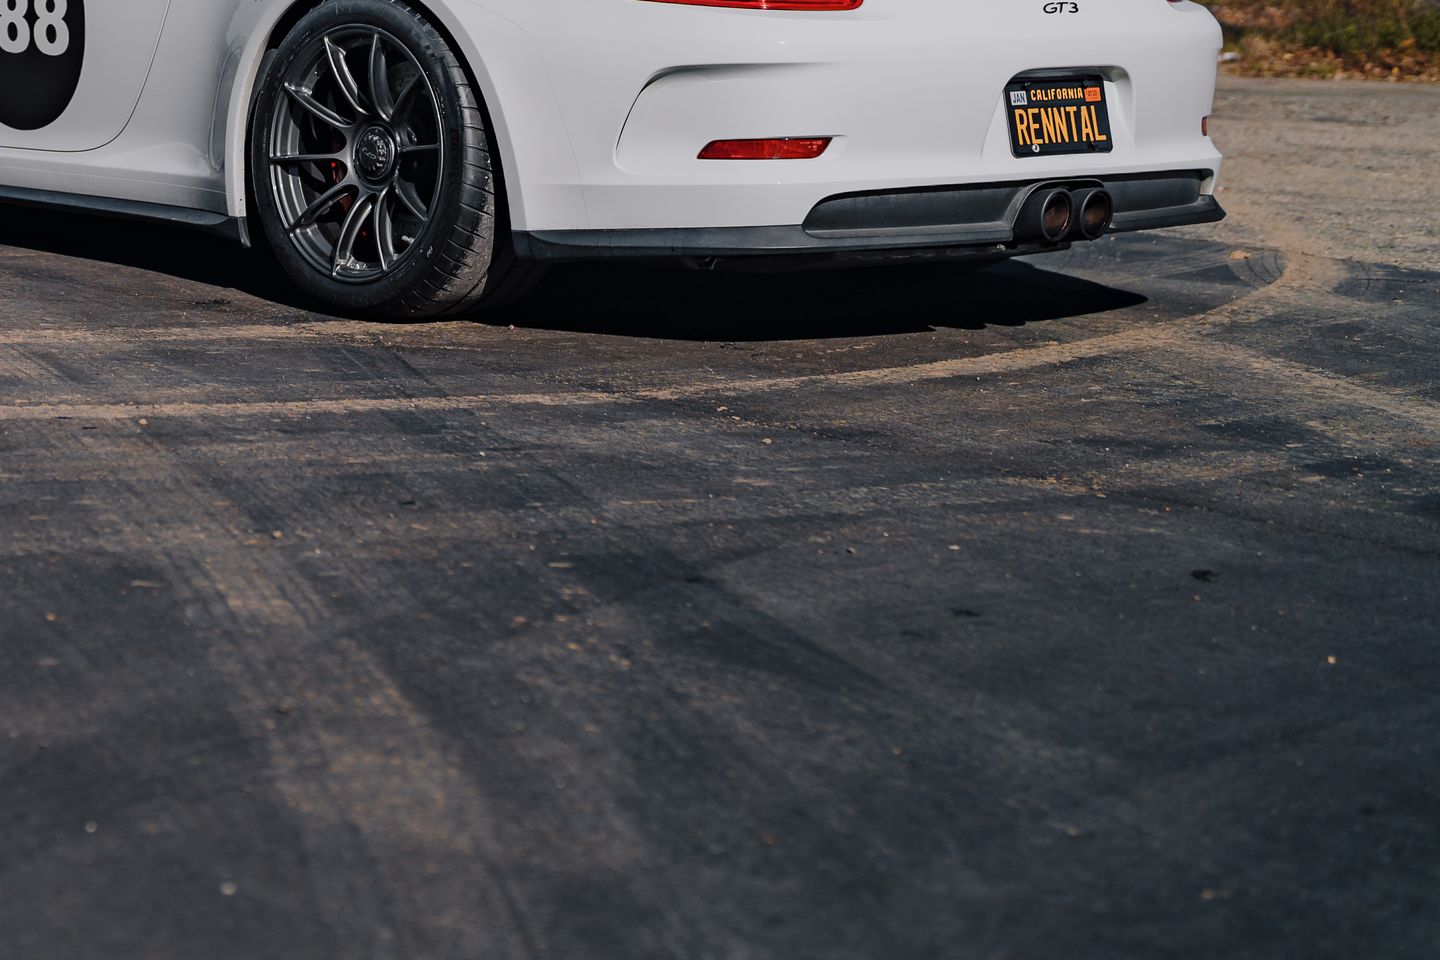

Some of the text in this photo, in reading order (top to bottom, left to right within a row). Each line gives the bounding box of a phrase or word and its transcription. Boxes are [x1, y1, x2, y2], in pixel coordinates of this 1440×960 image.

[1043, 2, 1079, 14] GT3
[1012, 91, 1026, 104] JAN
[1030, 87, 1083, 101] CALIFORNIA
[1014, 105, 1107, 145] RENNTAL
